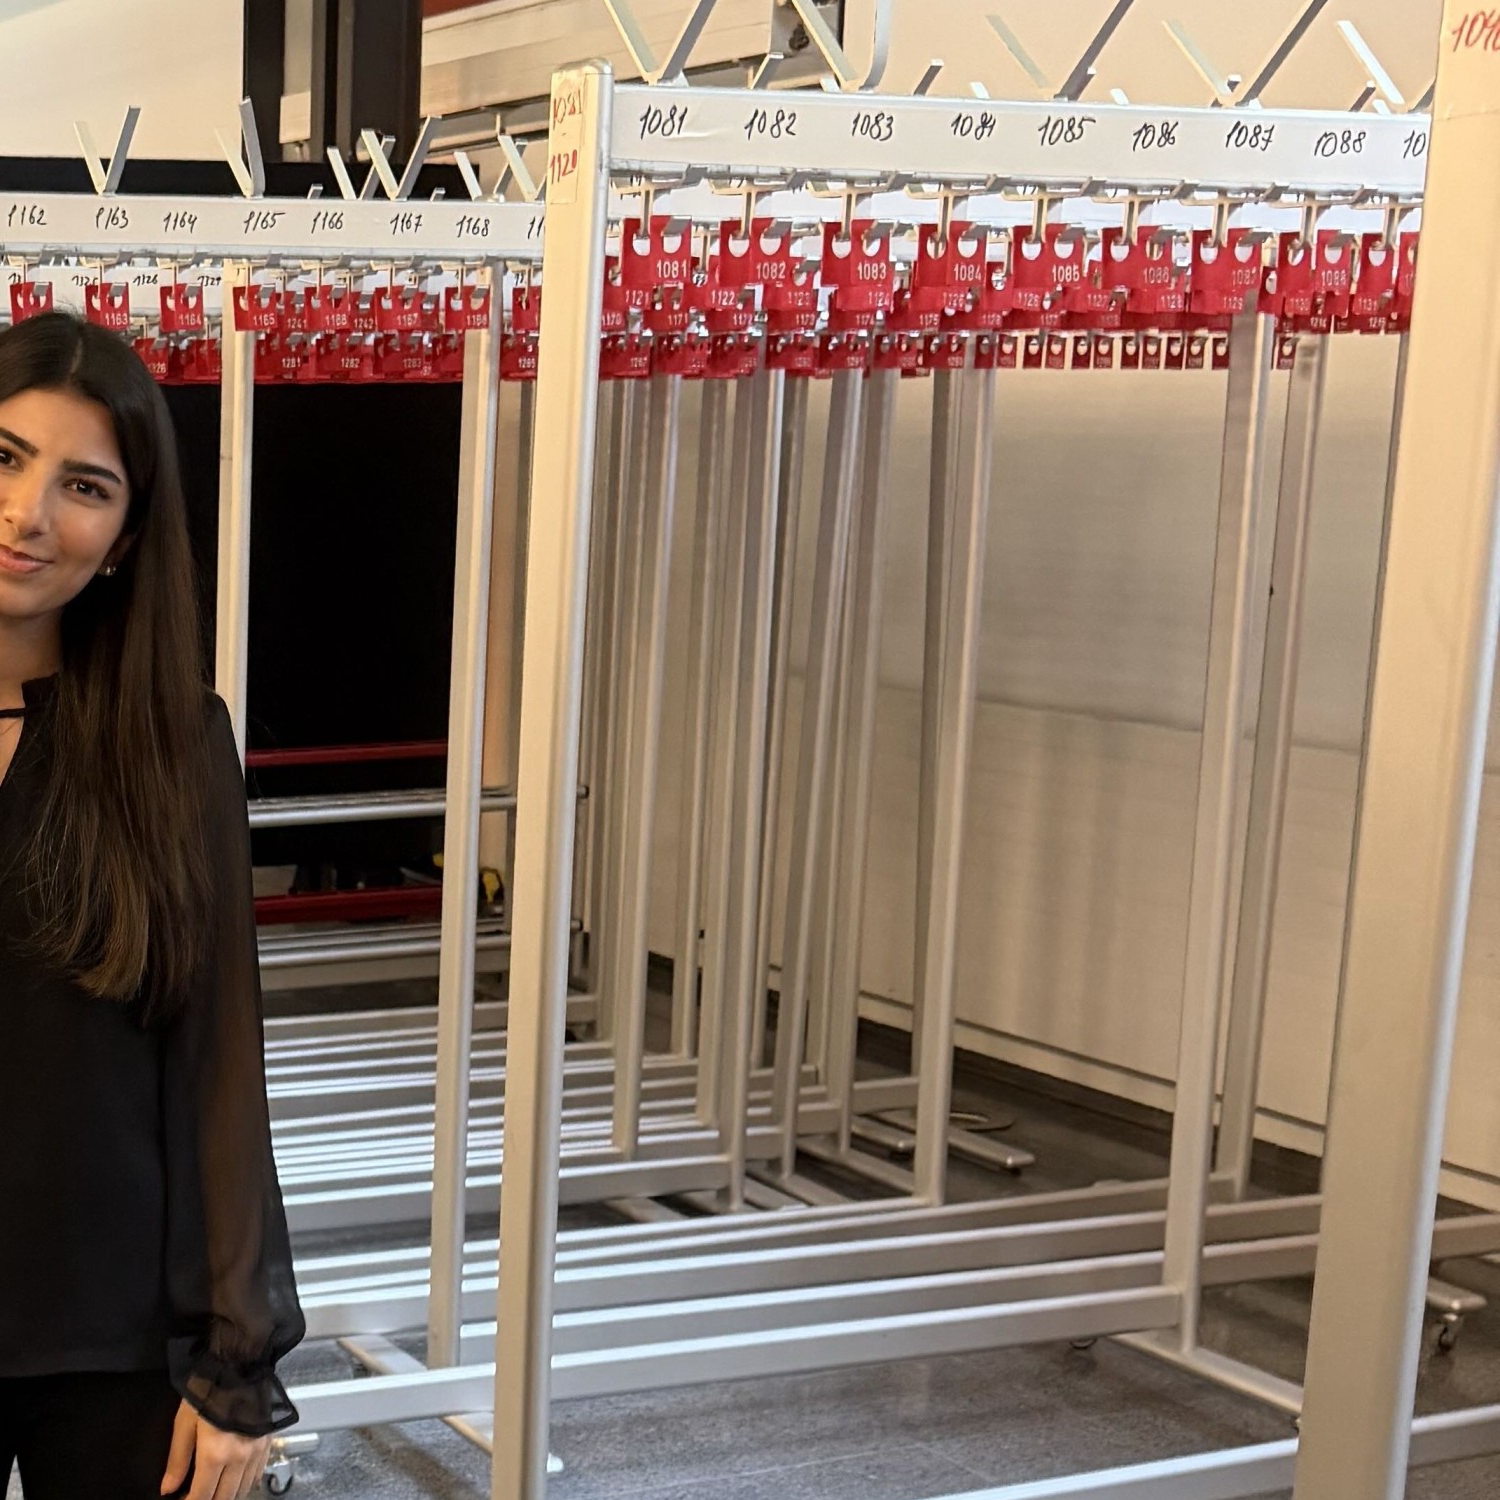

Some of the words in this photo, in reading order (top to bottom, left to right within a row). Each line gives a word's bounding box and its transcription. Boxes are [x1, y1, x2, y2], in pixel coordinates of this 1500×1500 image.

[553, 89, 582, 130] 1081
[639, 104, 688, 140] 1081
[744, 108, 797, 140] 1082
[852, 112, 894, 141] 1083
[950, 111, 996, 140] 1084
[1037, 115, 1097, 146] 1085
[1132, 121, 1179, 151] 1086
[1225, 120, 1275, 151] 1087
[1313, 129, 1367, 157] 1088
[1403, 129, 1426, 159] 10
[550, 149, 578, 185] 1120
[7, 203, 48, 227] 1162
[95, 206, 129, 230] 1163
[163, 211, 198, 234] 1164
[243, 210, 286, 234] 1165
[311, 210, 344, 234] 1166
[390, 212, 423, 236] 1167
[455, 215, 491, 238] 1168
[527, 215, 544, 240] 11
[656, 259, 688, 279] 1081
[755, 261, 786, 280] 1082
[857, 261, 887, 281] 1083
[953, 263, 982, 281] 1084
[1052, 264, 1080, 283] 1085
[132, 273, 159, 286] 1326
[625, 289, 650, 306] 1121
[711, 290, 736, 307] 1122
[104, 312, 129, 326] 1163
[178, 313, 203, 326] 1164
[252, 313, 276, 326] 1165
[147, 362, 167, 374] 326
